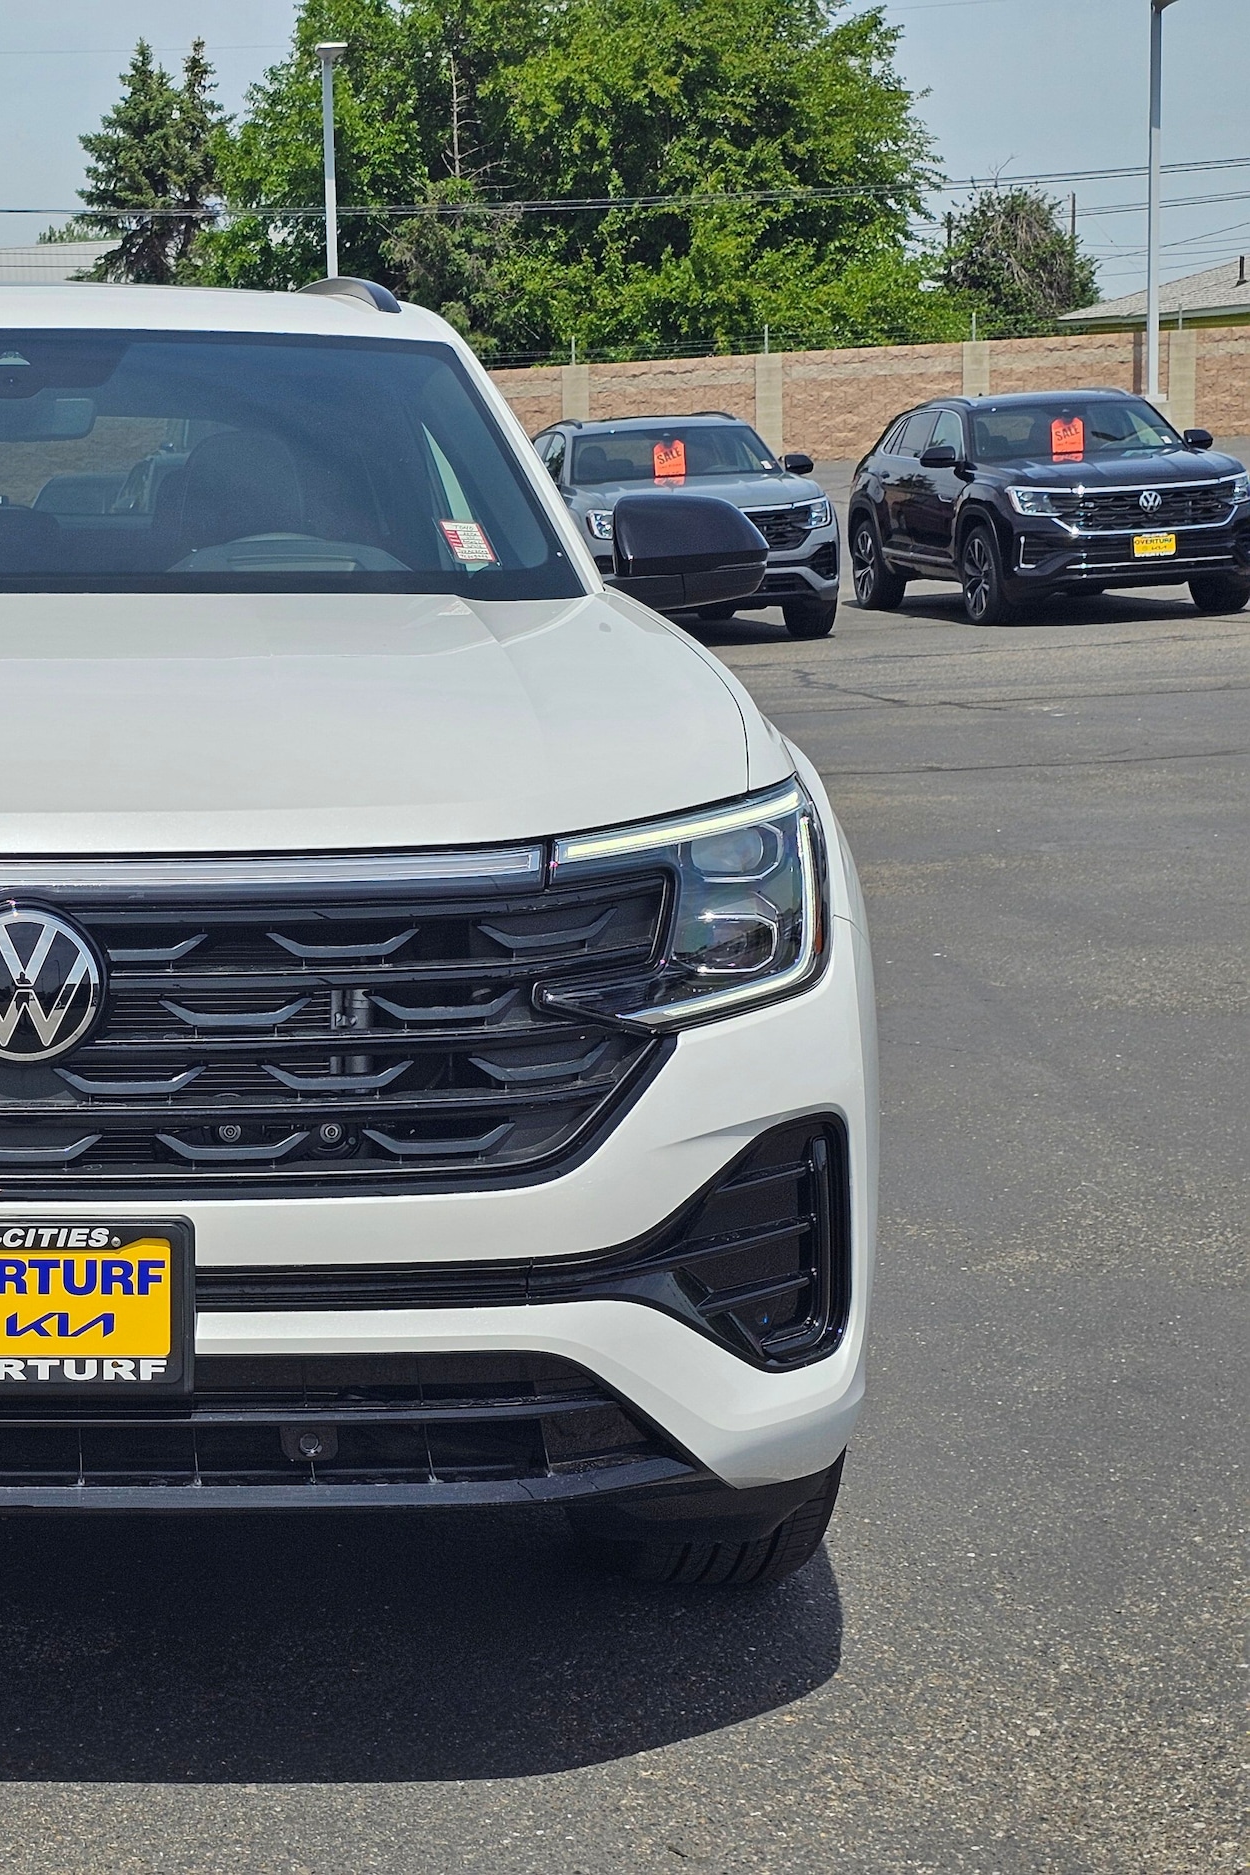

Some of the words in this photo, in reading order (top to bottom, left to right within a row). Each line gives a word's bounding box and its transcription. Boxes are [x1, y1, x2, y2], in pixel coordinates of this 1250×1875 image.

[1055, 424, 1080, 441] SALE
[657, 447, 681, 464] SALE
[6, 1312, 115, 1337] KIA
